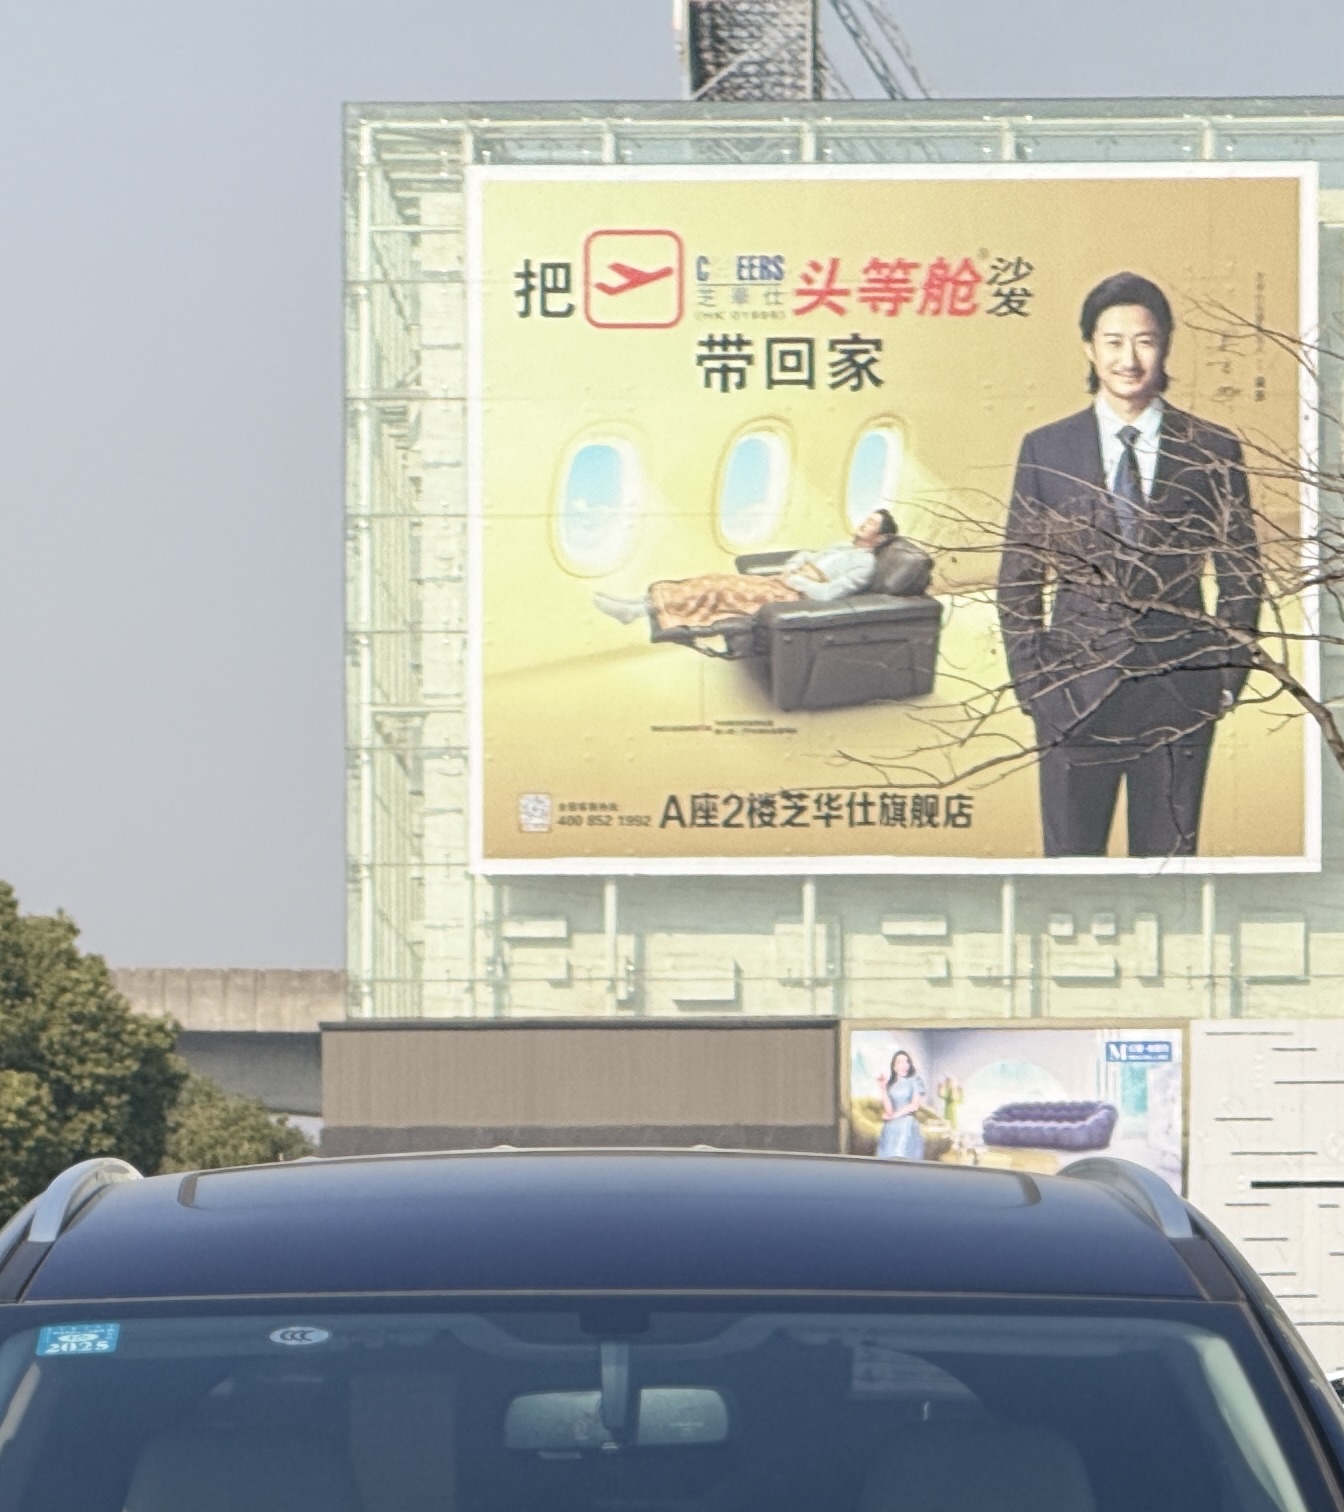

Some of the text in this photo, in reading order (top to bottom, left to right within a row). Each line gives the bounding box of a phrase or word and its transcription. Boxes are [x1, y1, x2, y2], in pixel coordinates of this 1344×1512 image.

[514, 256, 1033, 318] 把 头等舱 沙发
[696, 333, 885, 393] 带回家
[659, 792, 975, 830] A座2楼芝华仕旗舰店
[45, 1340, 110, 1354] 2025
